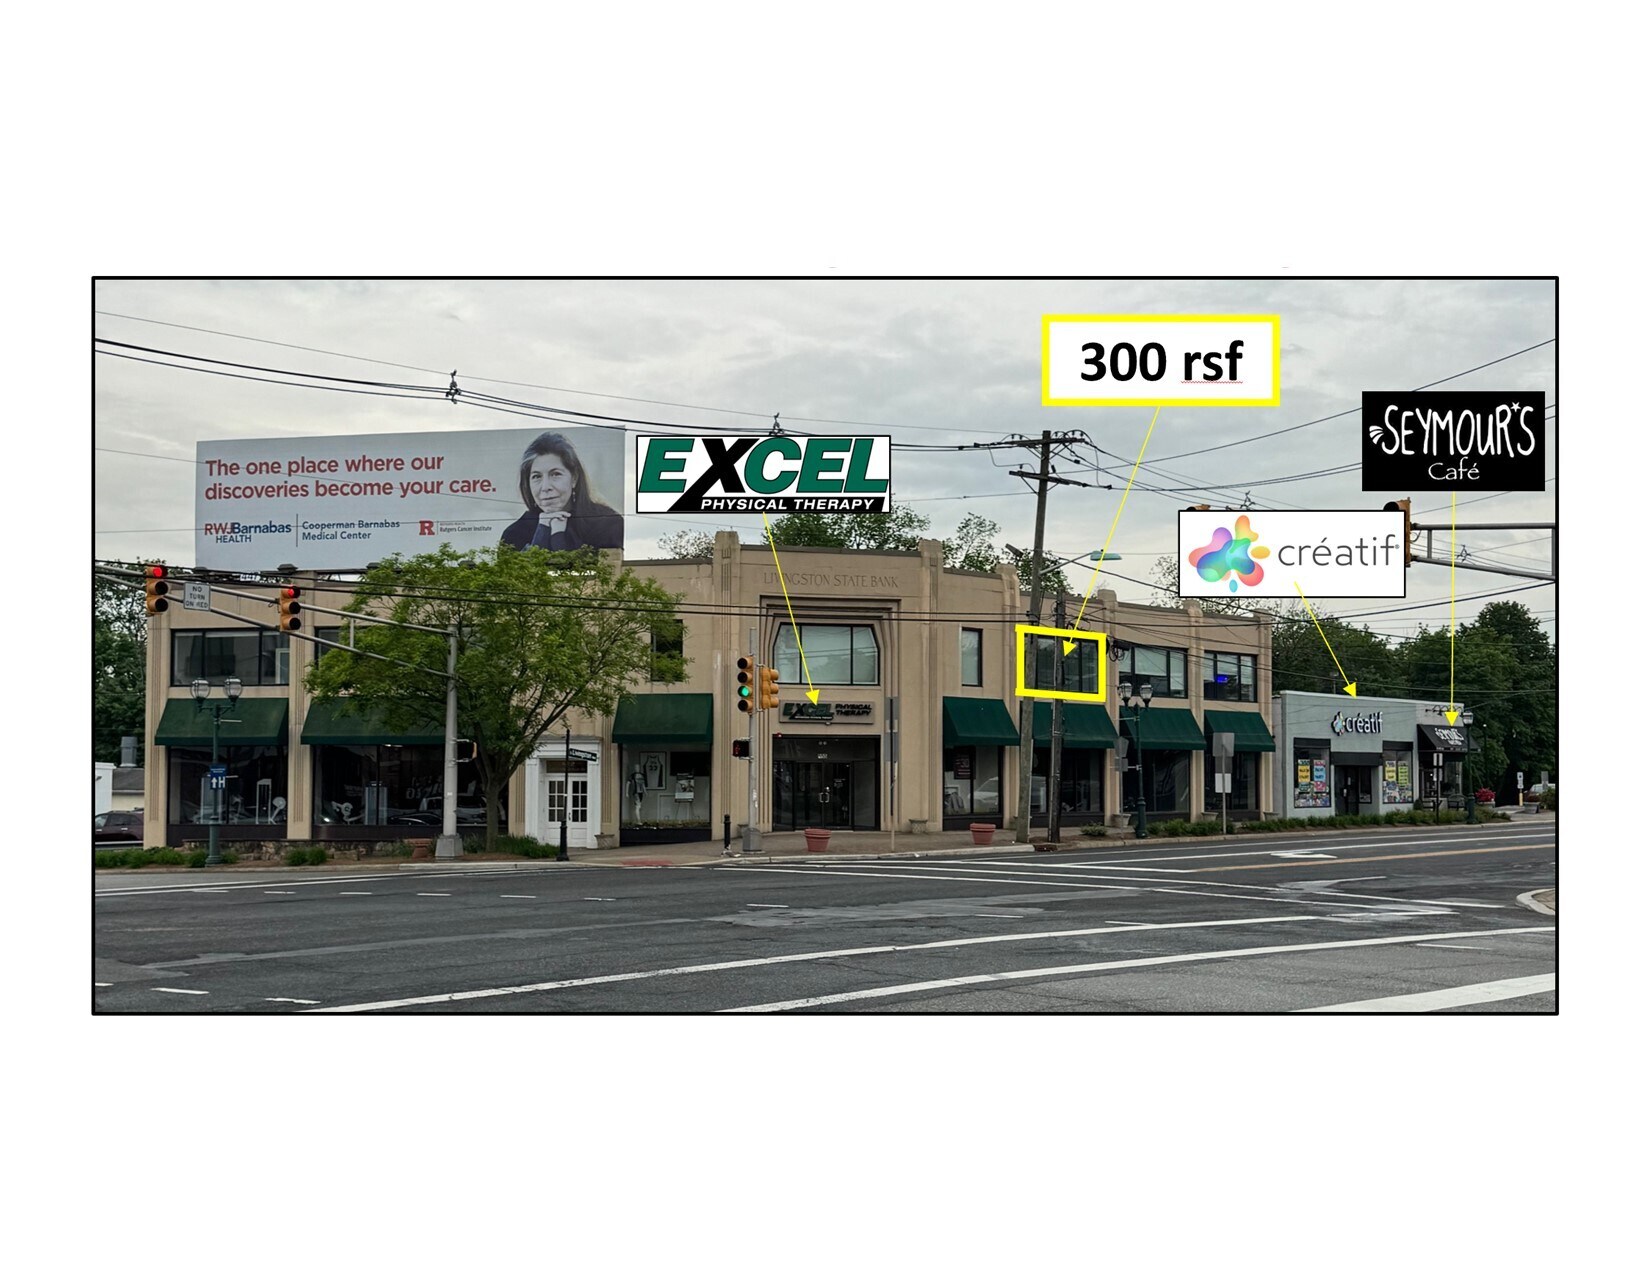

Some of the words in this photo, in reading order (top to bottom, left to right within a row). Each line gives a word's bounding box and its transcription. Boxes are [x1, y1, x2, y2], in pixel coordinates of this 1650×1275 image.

[205, 459, 240, 477] The
[246, 460, 281, 475] one
[288, 456, 339, 477] place
[345, 455, 405, 472] where
[411, 456, 444, 470] our
[205, 481, 310, 500] discoveries
[315, 480, 393, 497] become
[399, 481, 443, 498] your
[449, 479, 497, 493] care.
[301, 520, 355, 533] Cooperman
[358, 519, 400, 529] Barnabas
[419, 520, 435, 536] R
[215, 534, 252, 544] HEALTH
[302, 531, 338, 541] Medical
[340, 531, 372, 540] Center
[833, 574, 868, 588] STATE
[870, 575, 899, 589] BANK
[782, 702, 834, 720] EXCEL
[1344, 711, 1383, 734] créatif
[218, 776, 226, 788] H
